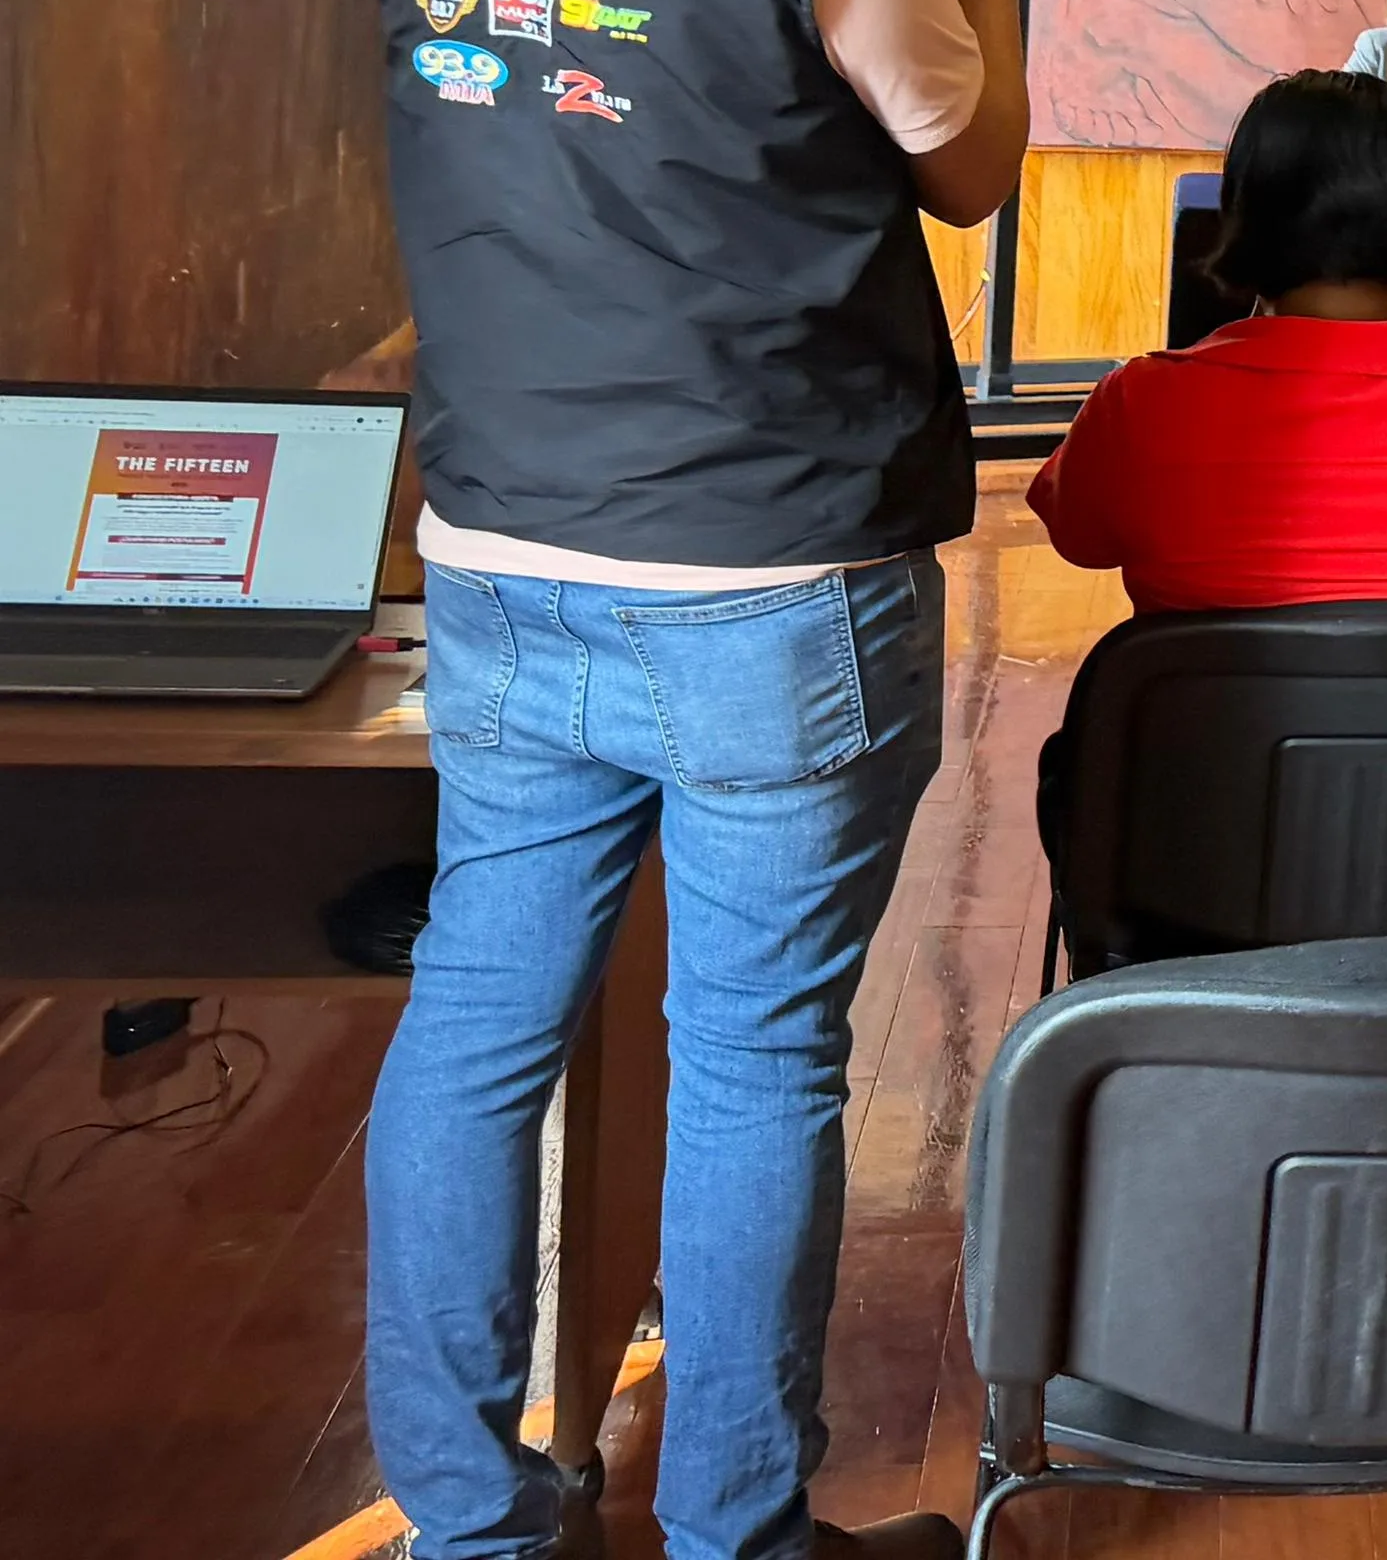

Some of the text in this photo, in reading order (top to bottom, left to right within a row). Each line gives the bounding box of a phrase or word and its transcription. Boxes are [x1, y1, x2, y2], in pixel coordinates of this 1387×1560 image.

[419, 45, 500, 83] 93.9
[116, 456, 250, 474] THE FIFTEEN
